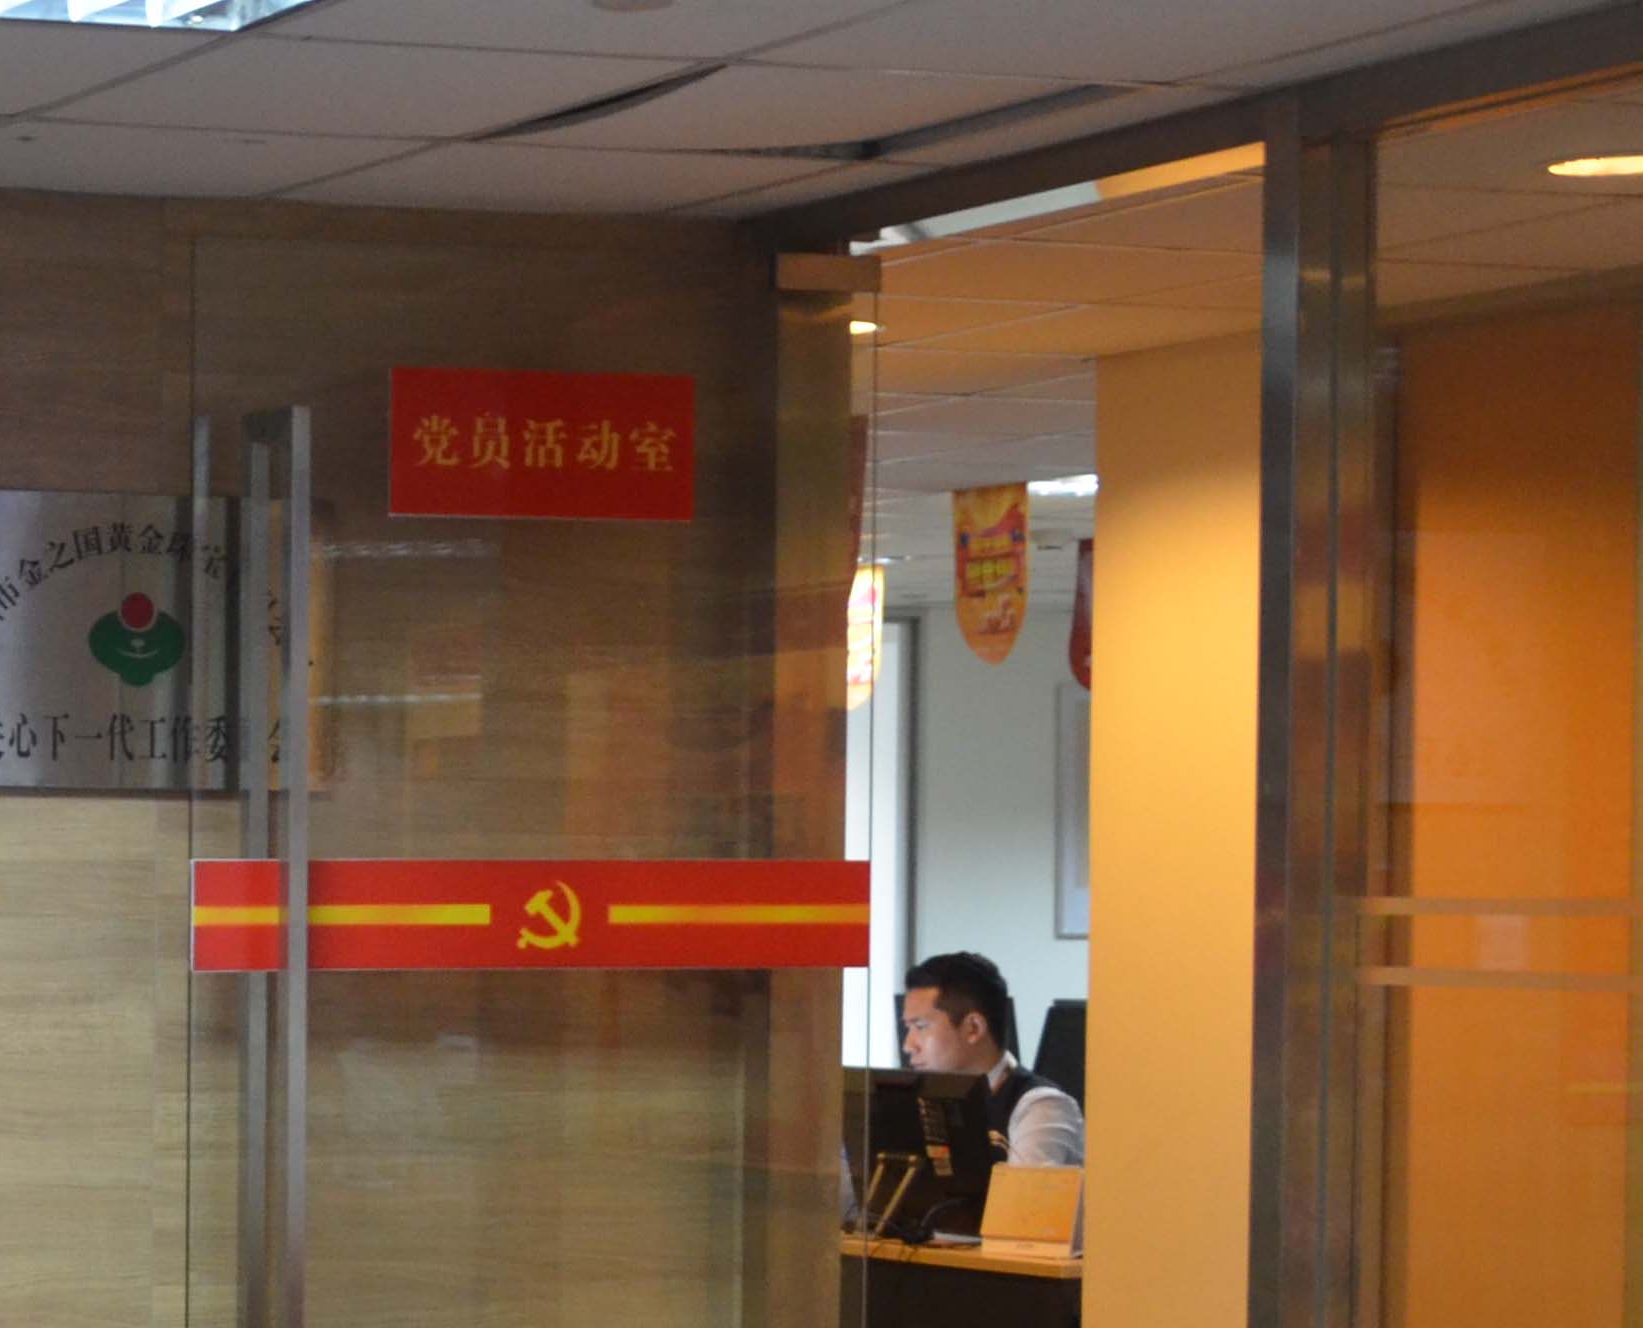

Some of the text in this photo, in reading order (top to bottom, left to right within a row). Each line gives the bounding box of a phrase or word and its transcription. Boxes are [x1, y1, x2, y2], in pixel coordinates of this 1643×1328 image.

[412, 414, 678, 472] 党员活动室
